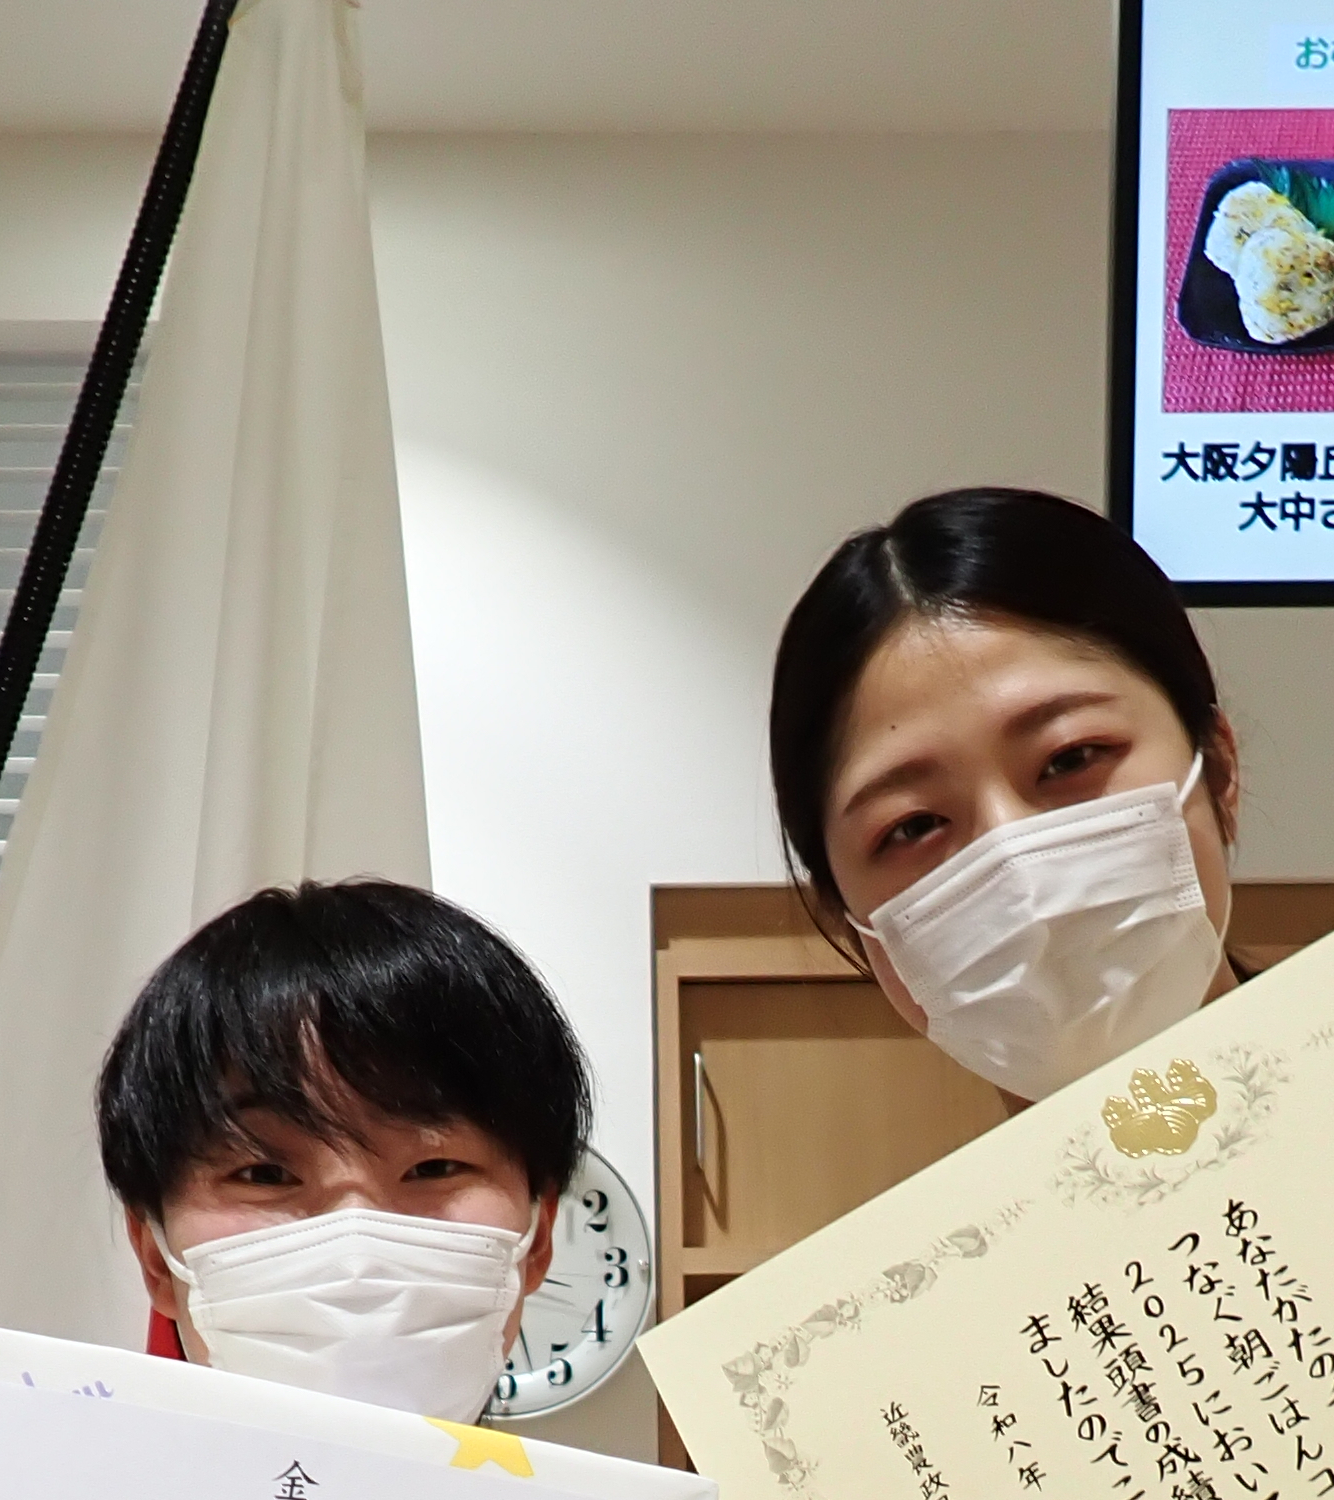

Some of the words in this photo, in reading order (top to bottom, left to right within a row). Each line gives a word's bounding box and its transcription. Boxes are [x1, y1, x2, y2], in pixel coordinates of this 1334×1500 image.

[581, 1188, 610, 1234] 2
[604, 1246, 630, 1289] 3
[581, 1298, 613, 1344] 4
[547, 1342, 573, 1387] 5
